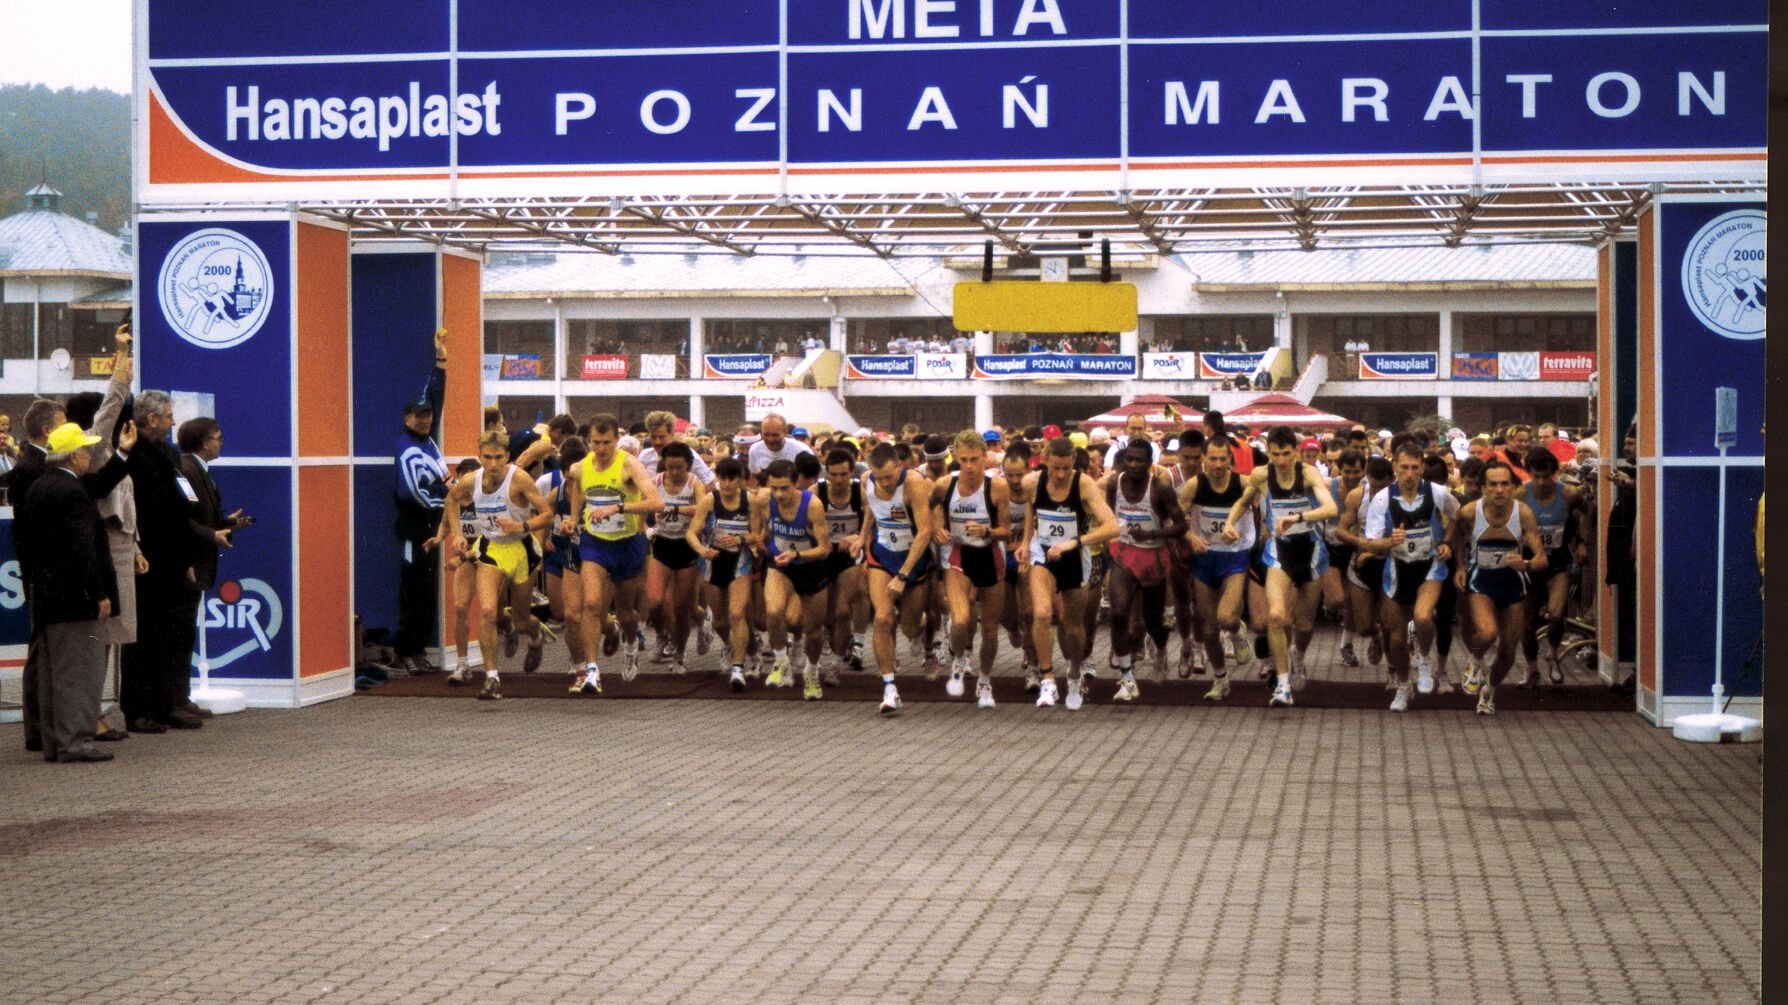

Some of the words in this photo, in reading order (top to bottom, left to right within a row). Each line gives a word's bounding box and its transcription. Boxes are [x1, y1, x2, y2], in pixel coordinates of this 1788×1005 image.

[226, 80, 500, 151] Hansaplast
[556, 75, 1048, 135] POZNAŃ
[1164, 71, 1726, 125] MARATON
[1734, 249, 1765, 261] 2000
[204, 266, 232, 276] 2000
[584, 357, 625, 370] terravita
[718, 358, 765, 371] Hansaplast
[861, 359, 909, 372] Hansaplast
[983, 359, 1027, 372] Hansaplast
[1079, 360, 1133, 371] MARATON
[1376, 358, 1430, 372] Hansaplast
[1543, 356, 1593, 369] terravita
[774, 523, 805, 536] POLAND
[1050, 525, 1065, 537] 29
[889, 532, 897, 543] 8
[1408, 542, 1416, 553] 9
[1494, 554, 1503, 564] 7
